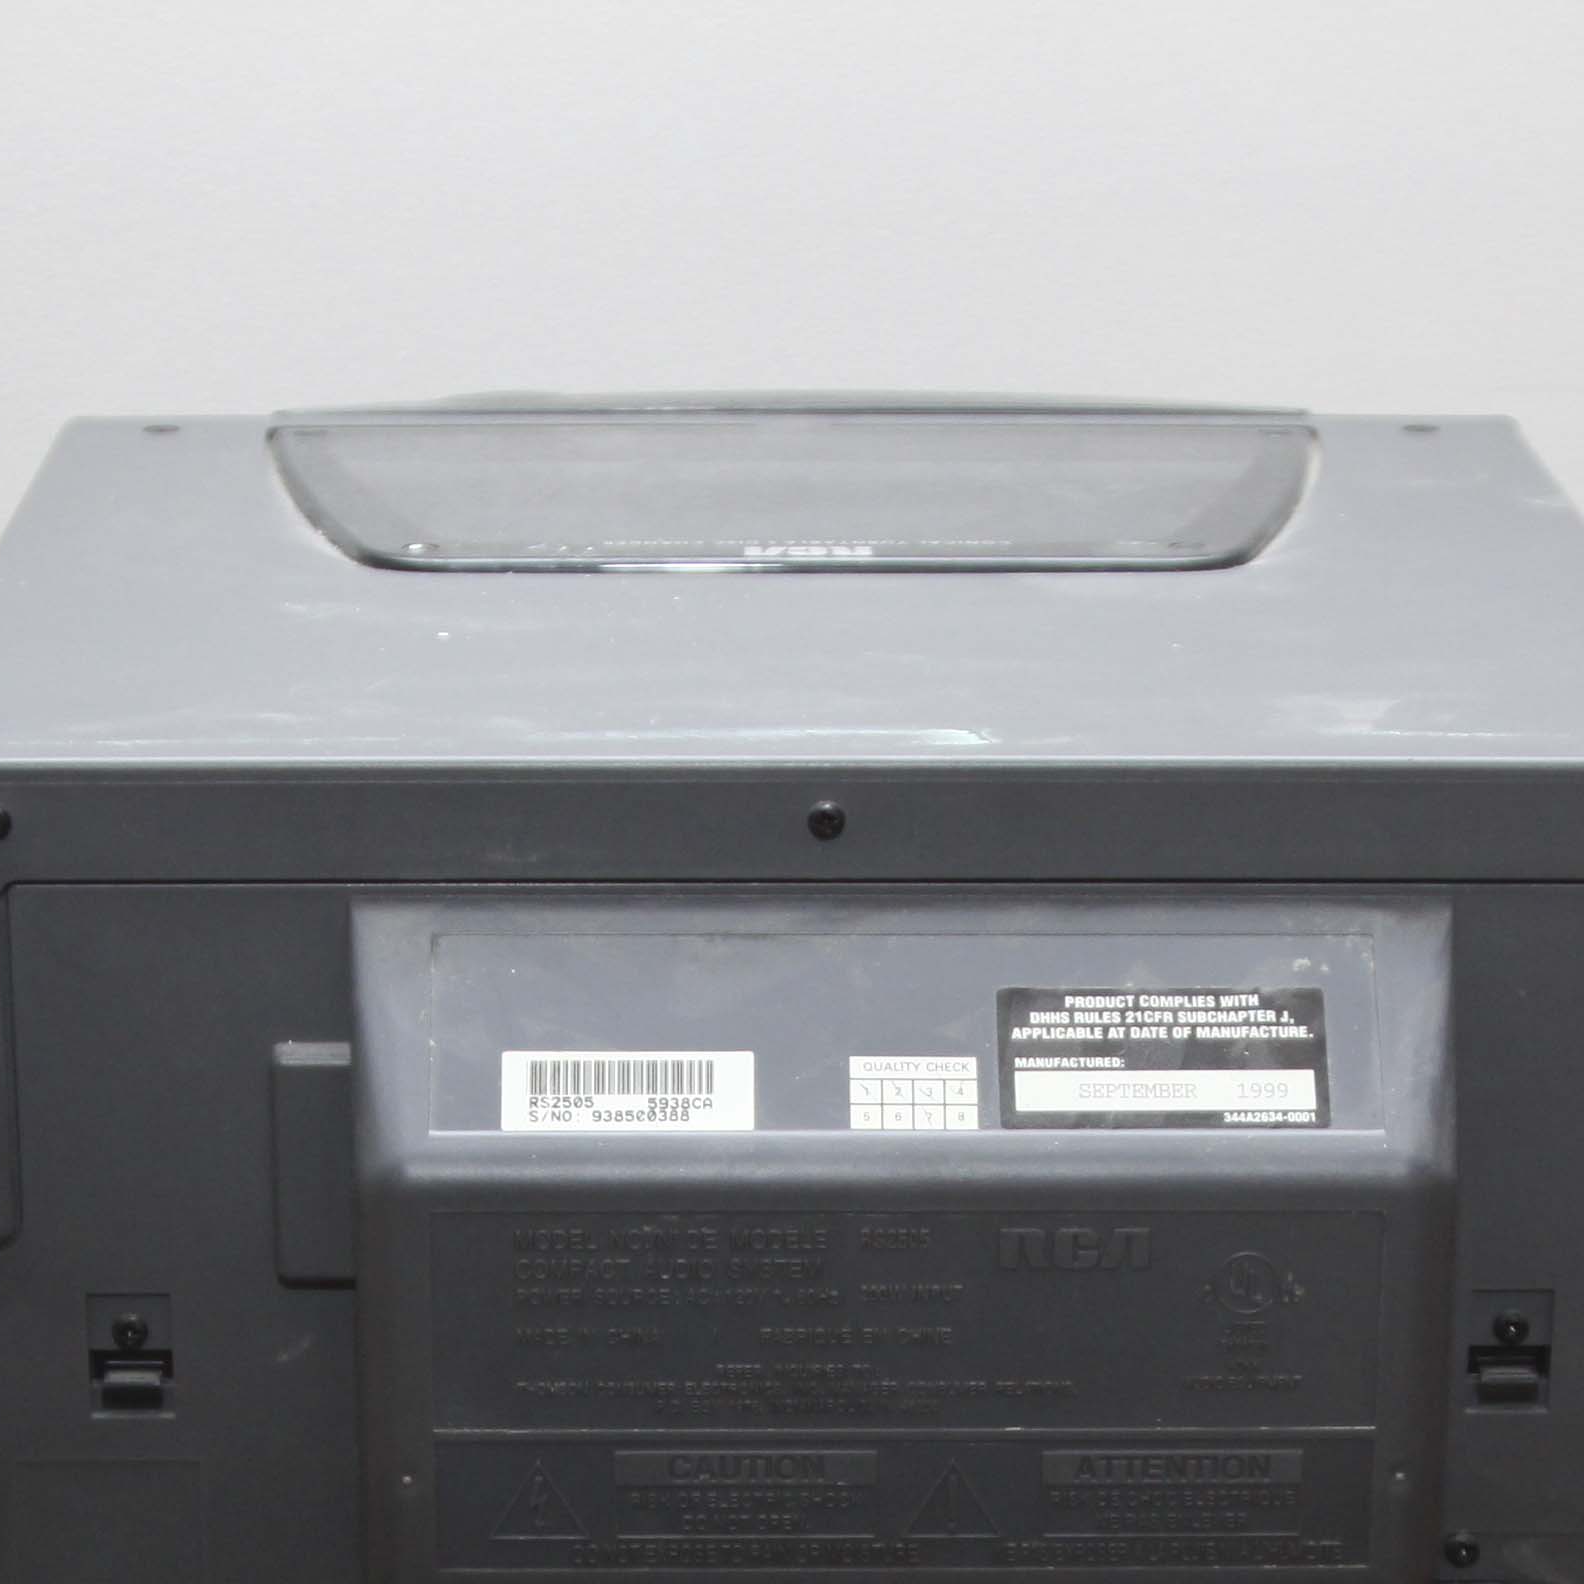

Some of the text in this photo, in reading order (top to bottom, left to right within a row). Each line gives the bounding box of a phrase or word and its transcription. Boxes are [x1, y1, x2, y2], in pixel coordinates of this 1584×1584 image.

[1064, 994, 1259, 1009] PRODUCT COMPLIES WITH
[1029, 1010, 1071, 1025] DHHS
[1074, 1010, 1122, 1024] RULES
[1124, 1010, 1174, 1024] 21CFR
[1177, 1010, 1277, 1024] SUBCHAPTER
[1011, 1025, 1315, 1040] APPLICABLE AT DATE OF MANUFACTURE.
[863, 1062, 971, 1073] QUALITY CHECK
[1014, 1056, 1126, 1070] MANUFACTURED:
[1078, 1081, 1290, 1100] SEPTEMBER 1999
[528, 1096, 714, 1110] RS2505 5938CA
[999, 1227, 1152, 1271] RCA
[668, 1455, 825, 1484] CAUTION
[1074, 1454, 1272, 1484] ATTENTION
